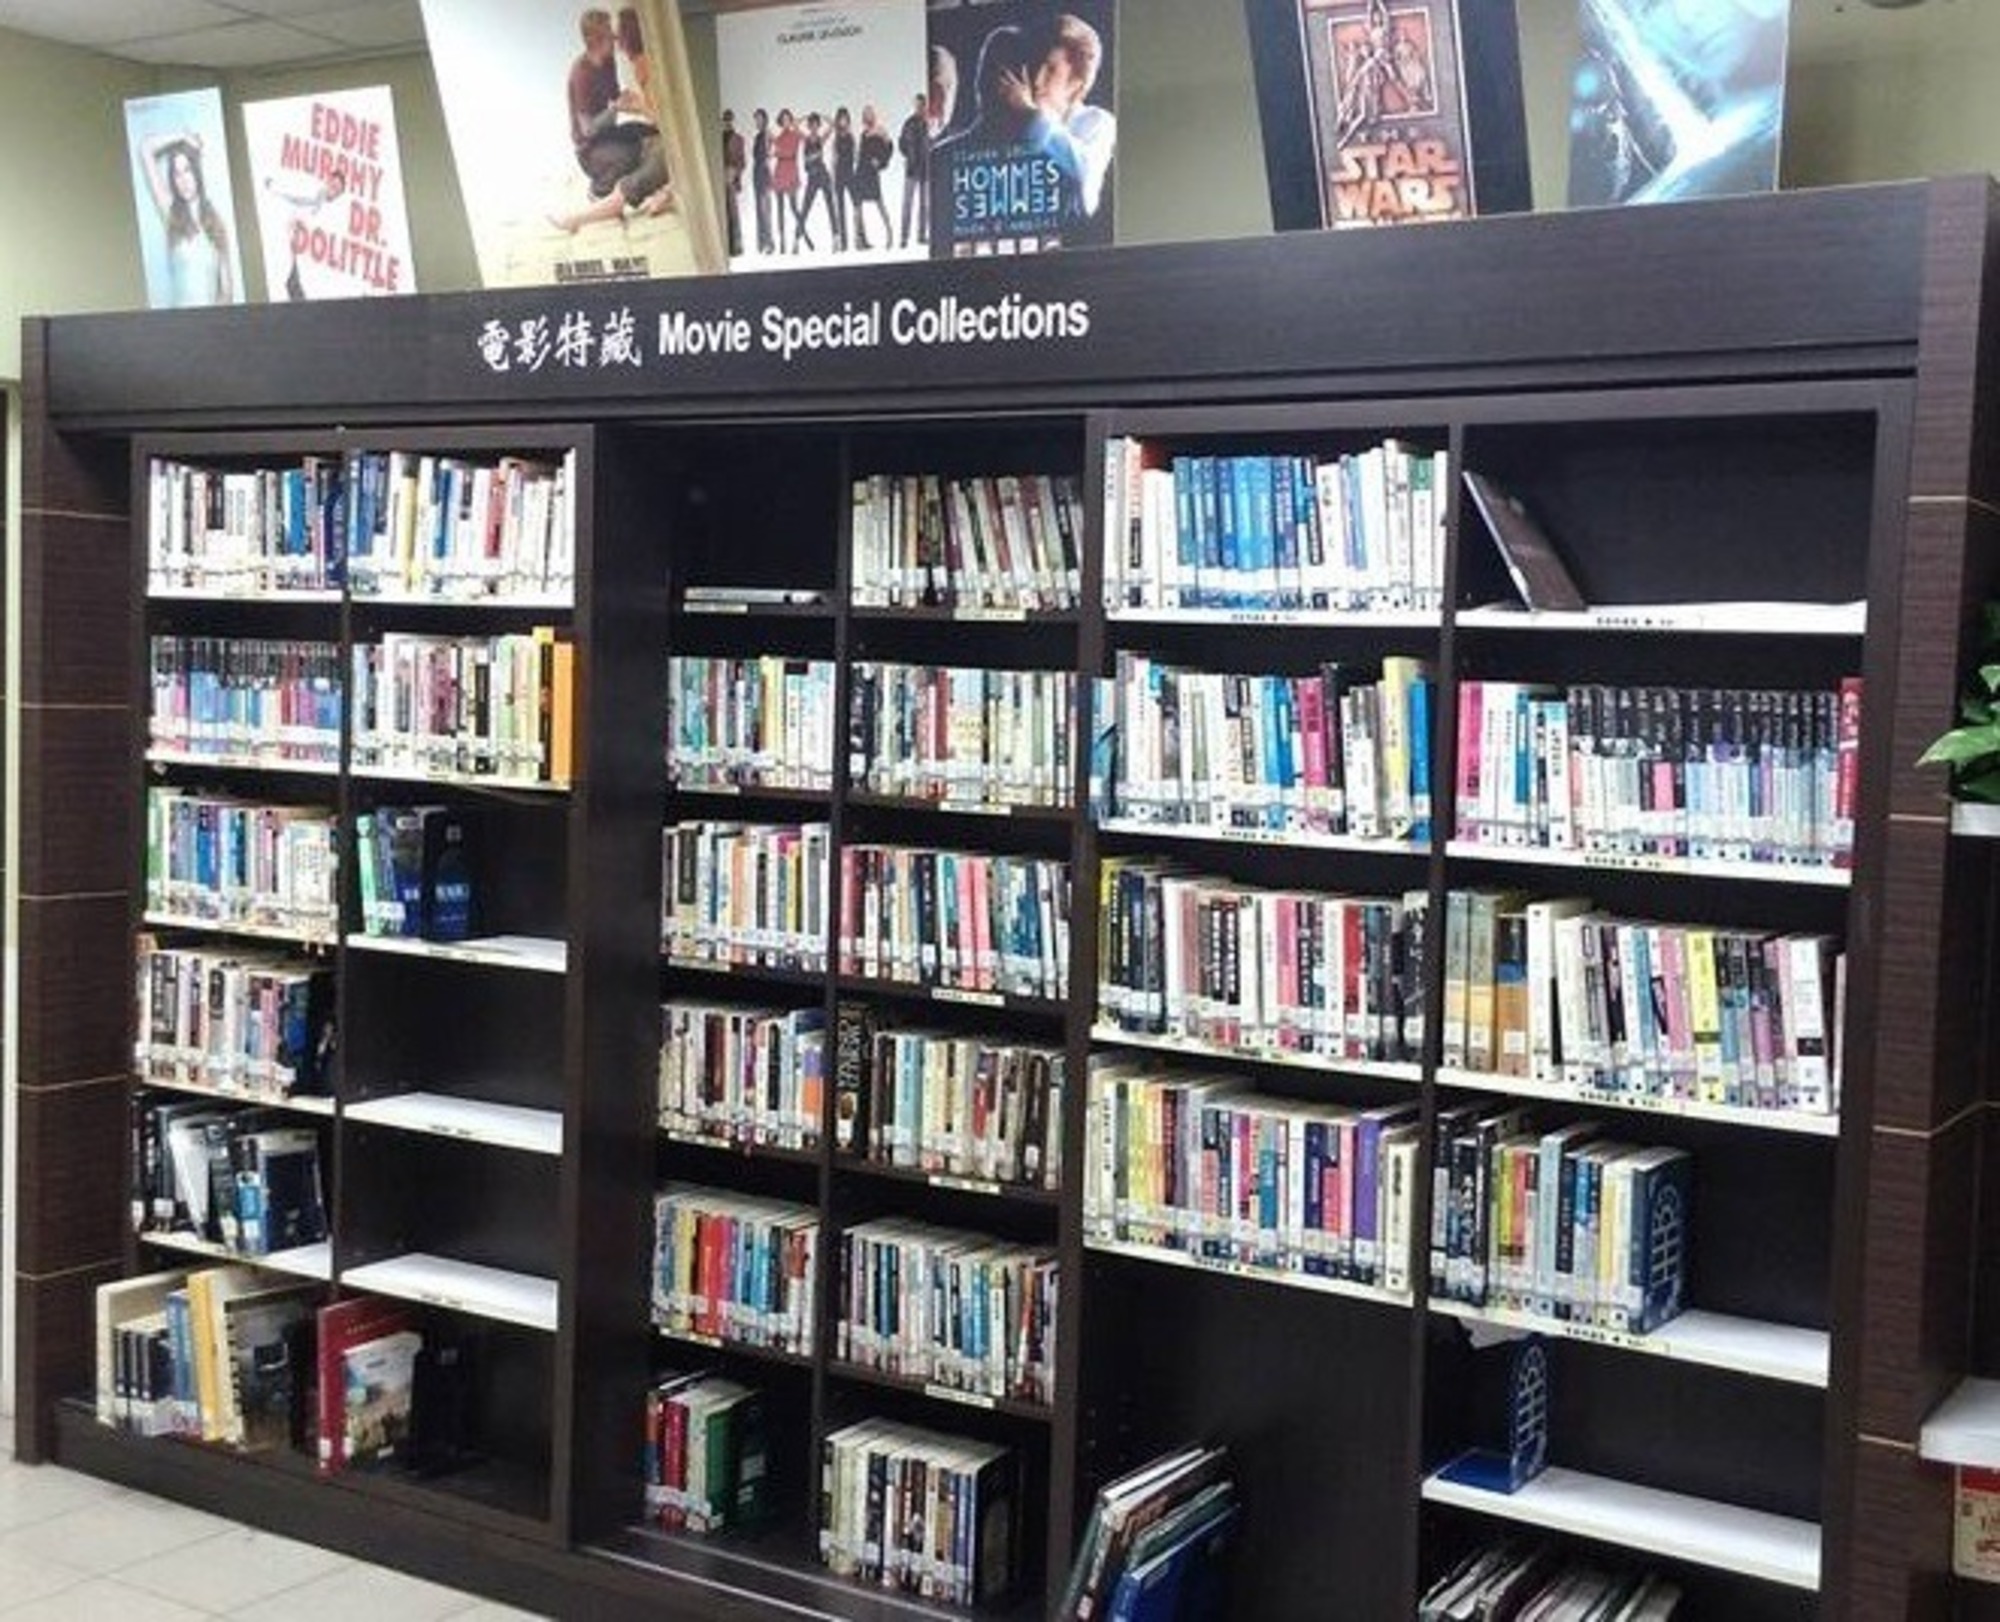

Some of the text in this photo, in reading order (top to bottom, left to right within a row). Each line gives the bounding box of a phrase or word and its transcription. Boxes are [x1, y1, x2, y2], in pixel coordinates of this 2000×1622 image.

[311, 102, 380, 161] EDDIE
[280, 132, 384, 202] MURPHY
[953, 160, 1060, 192] HOMMES
[1330, 139, 1459, 181] STAR
[348, 200, 387, 246] DR.
[1335, 175, 1461, 219] WARS
[290, 220, 400, 290] DOLITTLE
[477, 293, 1090, 372] 電影特藏 Movie Special Collections
